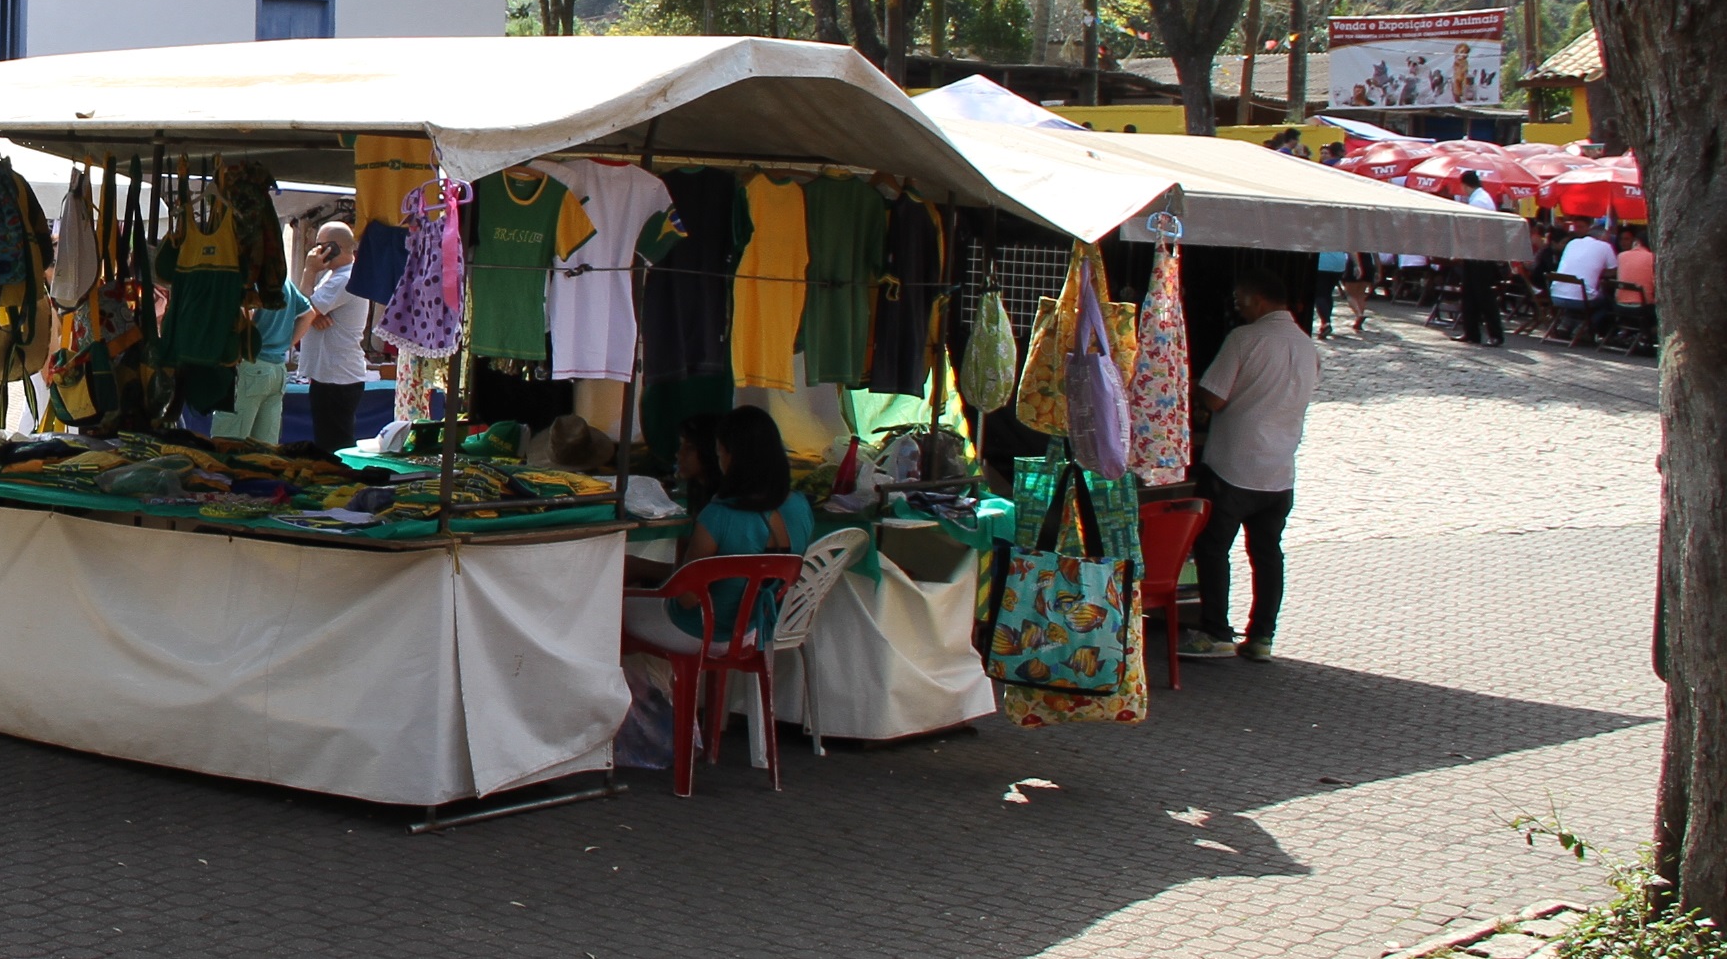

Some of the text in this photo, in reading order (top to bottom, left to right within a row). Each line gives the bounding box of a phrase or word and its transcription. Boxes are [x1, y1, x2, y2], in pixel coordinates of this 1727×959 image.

[1333, 21, 1367, 31] Venda
[1368, 22, 1376, 30] e
[1435, 18, 1450, 27] de
[1452, 14, 1499, 27] Animais
[1371, 164, 1398, 175] TNT
[1416, 176, 1436, 187] TNT
[494, 228, 535, 243] BRASIL
